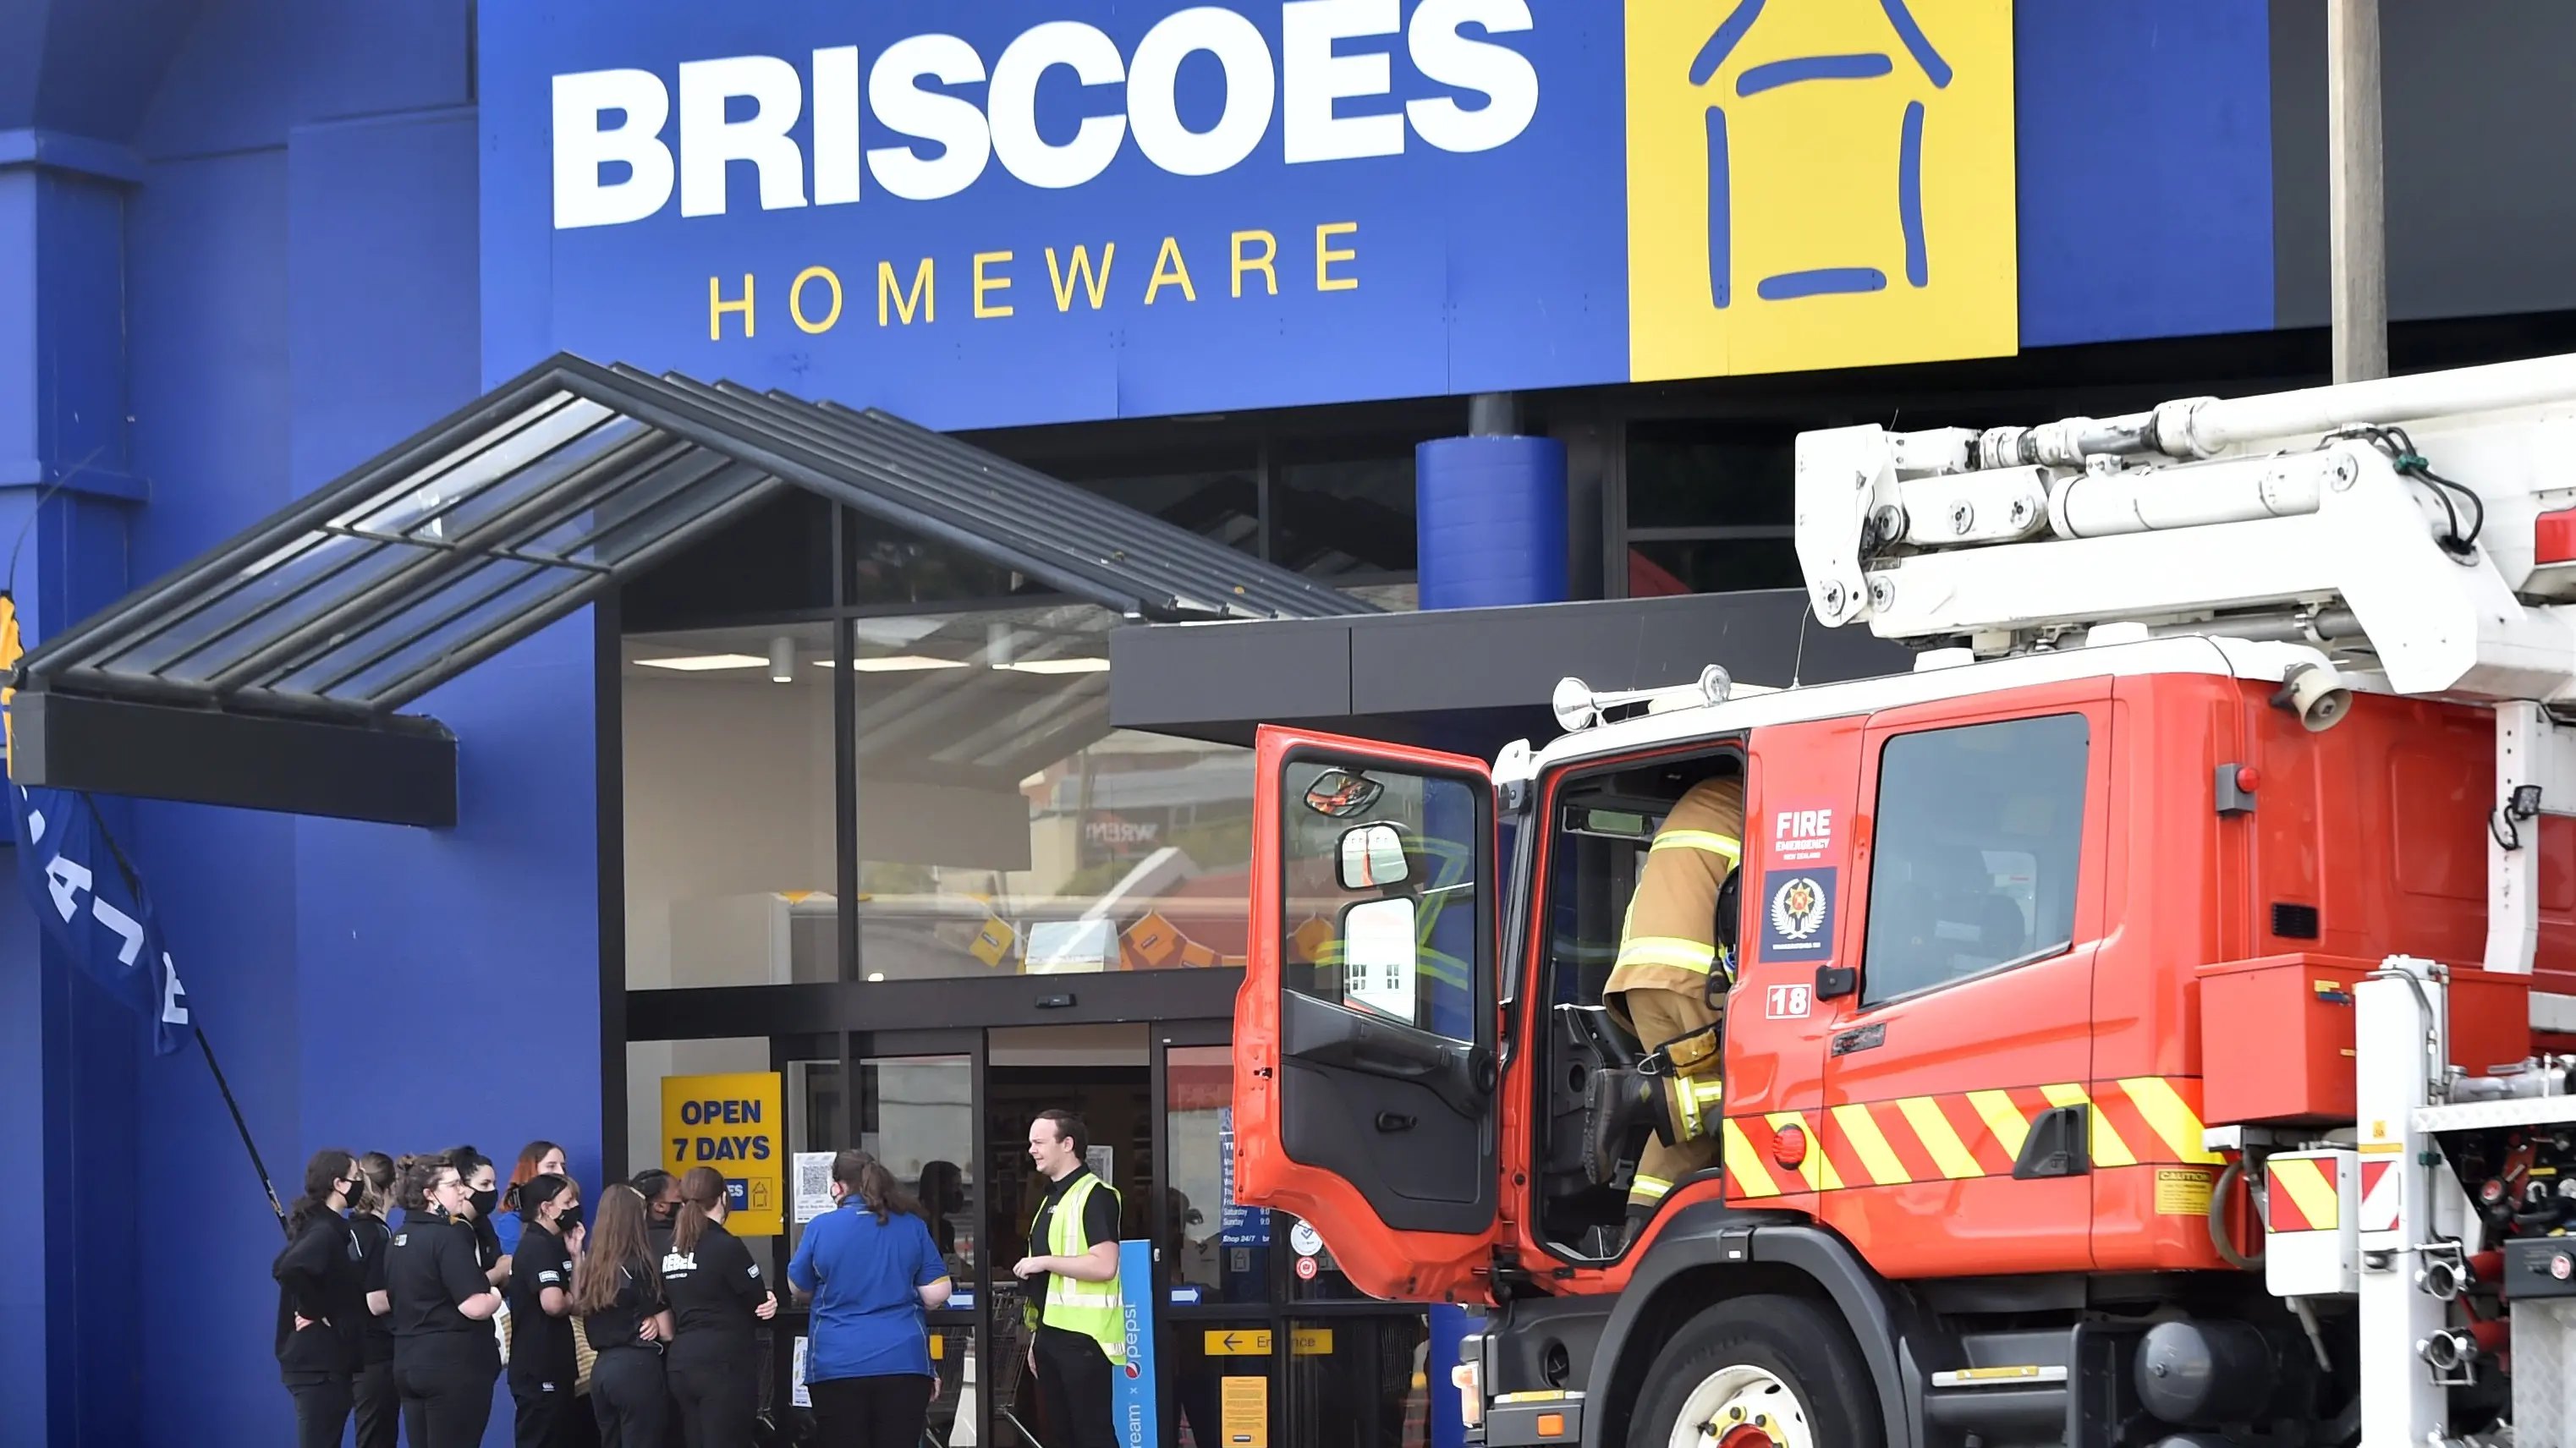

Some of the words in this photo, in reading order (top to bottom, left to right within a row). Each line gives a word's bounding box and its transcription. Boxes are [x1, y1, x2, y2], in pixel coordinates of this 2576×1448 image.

[552, 0, 1539, 229] BRISCOES
[708, 222, 1359, 341] HOMEWARE
[1777, 809, 1832, 839] FIRE
[1775, 838, 1830, 853] EMERGENCY
[1771, 987, 1807, 1015] 18
[681, 1100, 761, 1126] OPEN
[673, 1138, 689, 1161] 7
[696, 1136, 770, 1160] DAYS
[1223, 1208, 1248, 1217] Saturday
[1223, 1218, 1244, 1226] Sunday
[1222, 1235, 1240, 1243] Shop
[1124, 1302, 1141, 1358] pepsi
[1257, 1336, 1315, 1348] Ennce
